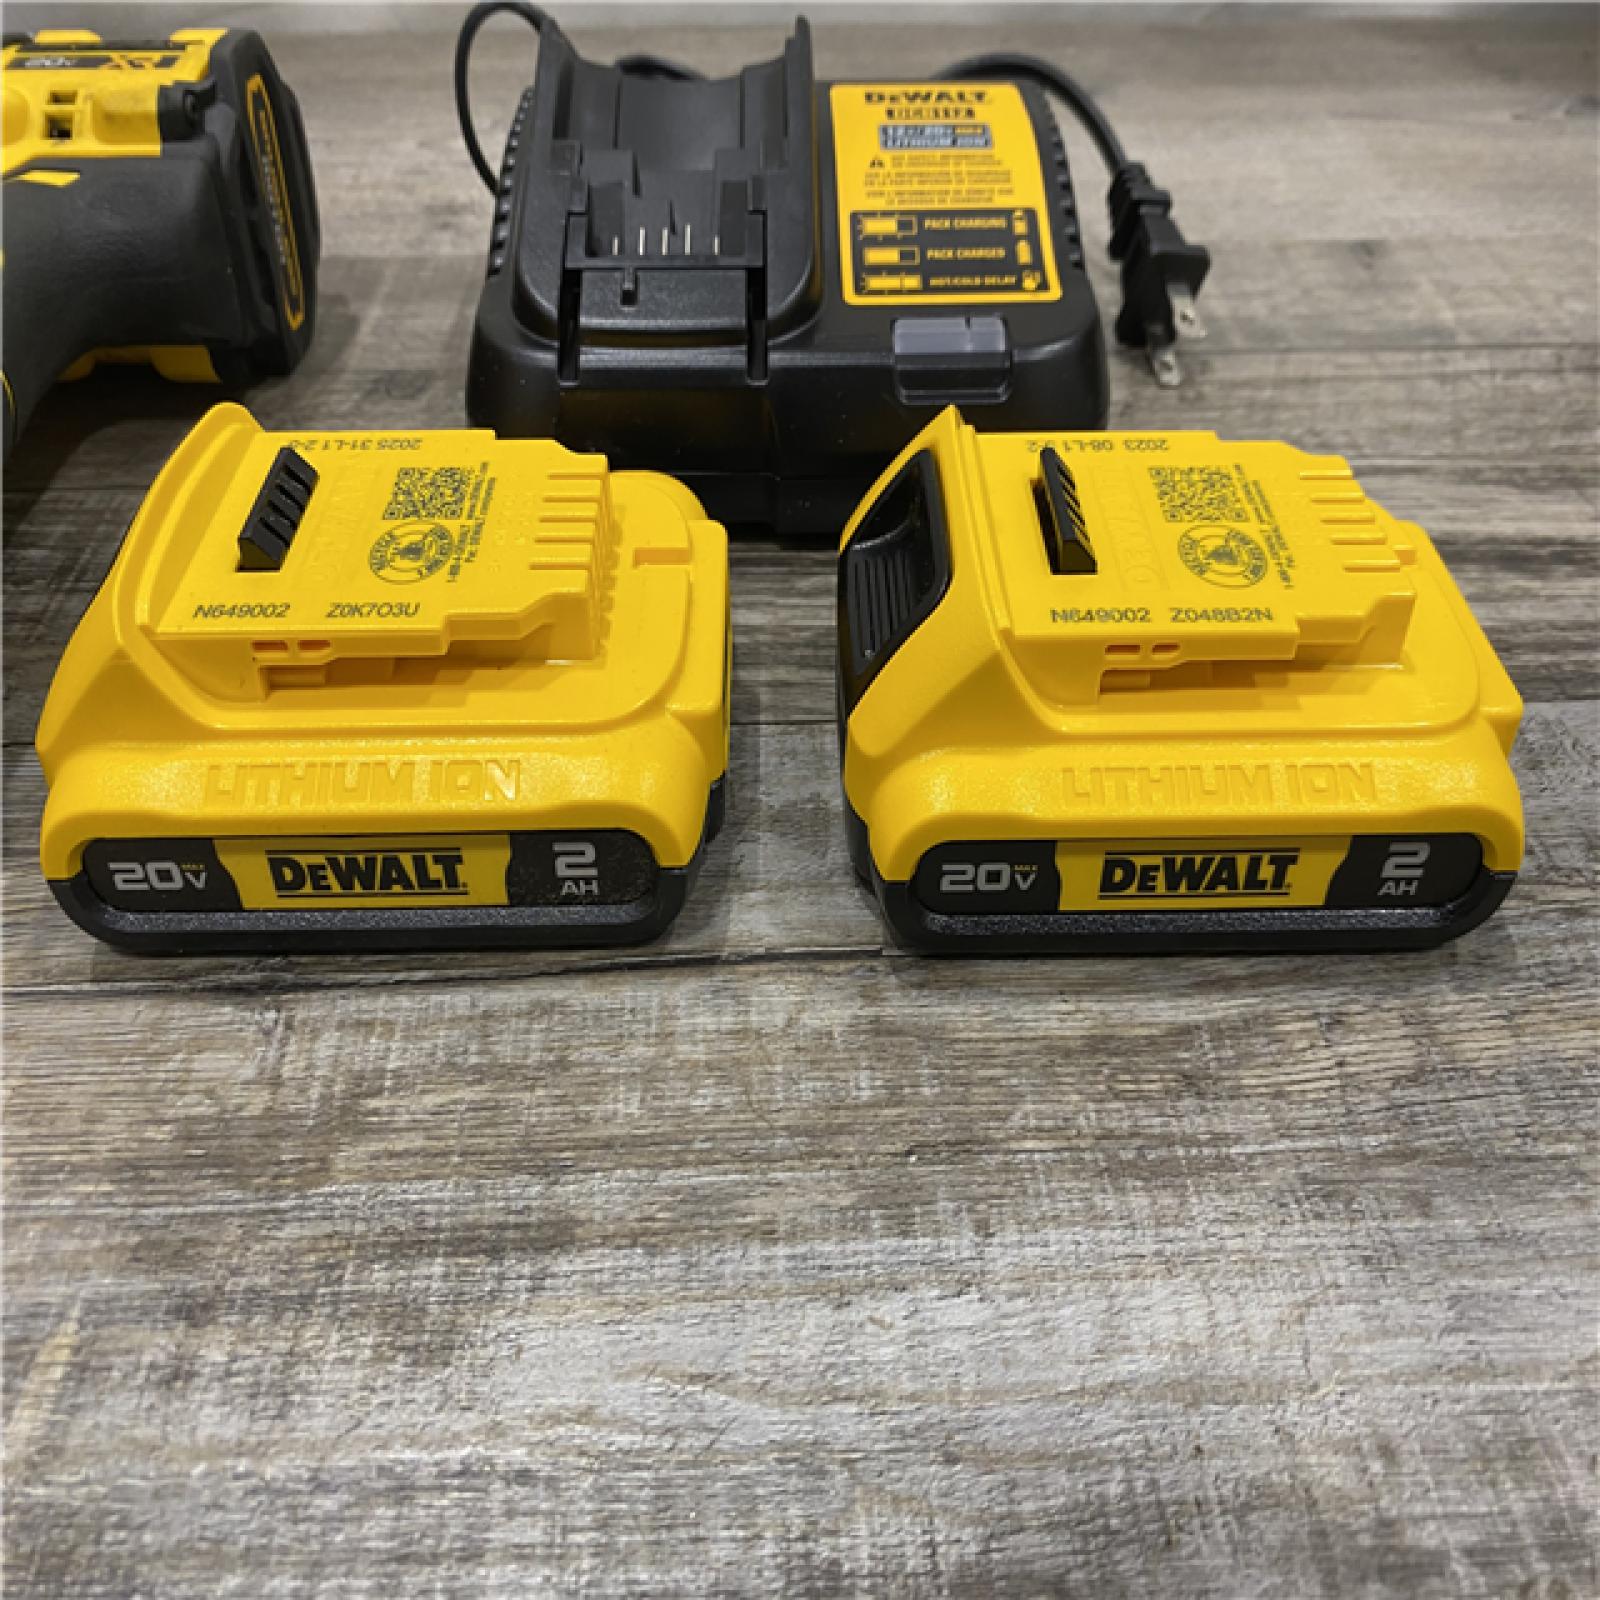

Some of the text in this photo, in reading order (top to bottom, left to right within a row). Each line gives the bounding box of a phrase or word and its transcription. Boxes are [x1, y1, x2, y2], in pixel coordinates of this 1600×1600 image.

[205, 760, 521, 803] LITHIUM ION
[1062, 763, 1377, 803] LITHIUM ION
[553, 842, 598, 878] 2
[1381, 842, 1431, 878] 2
[559, 879, 598, 897] AH
[1377, 879, 1419, 897] AH
